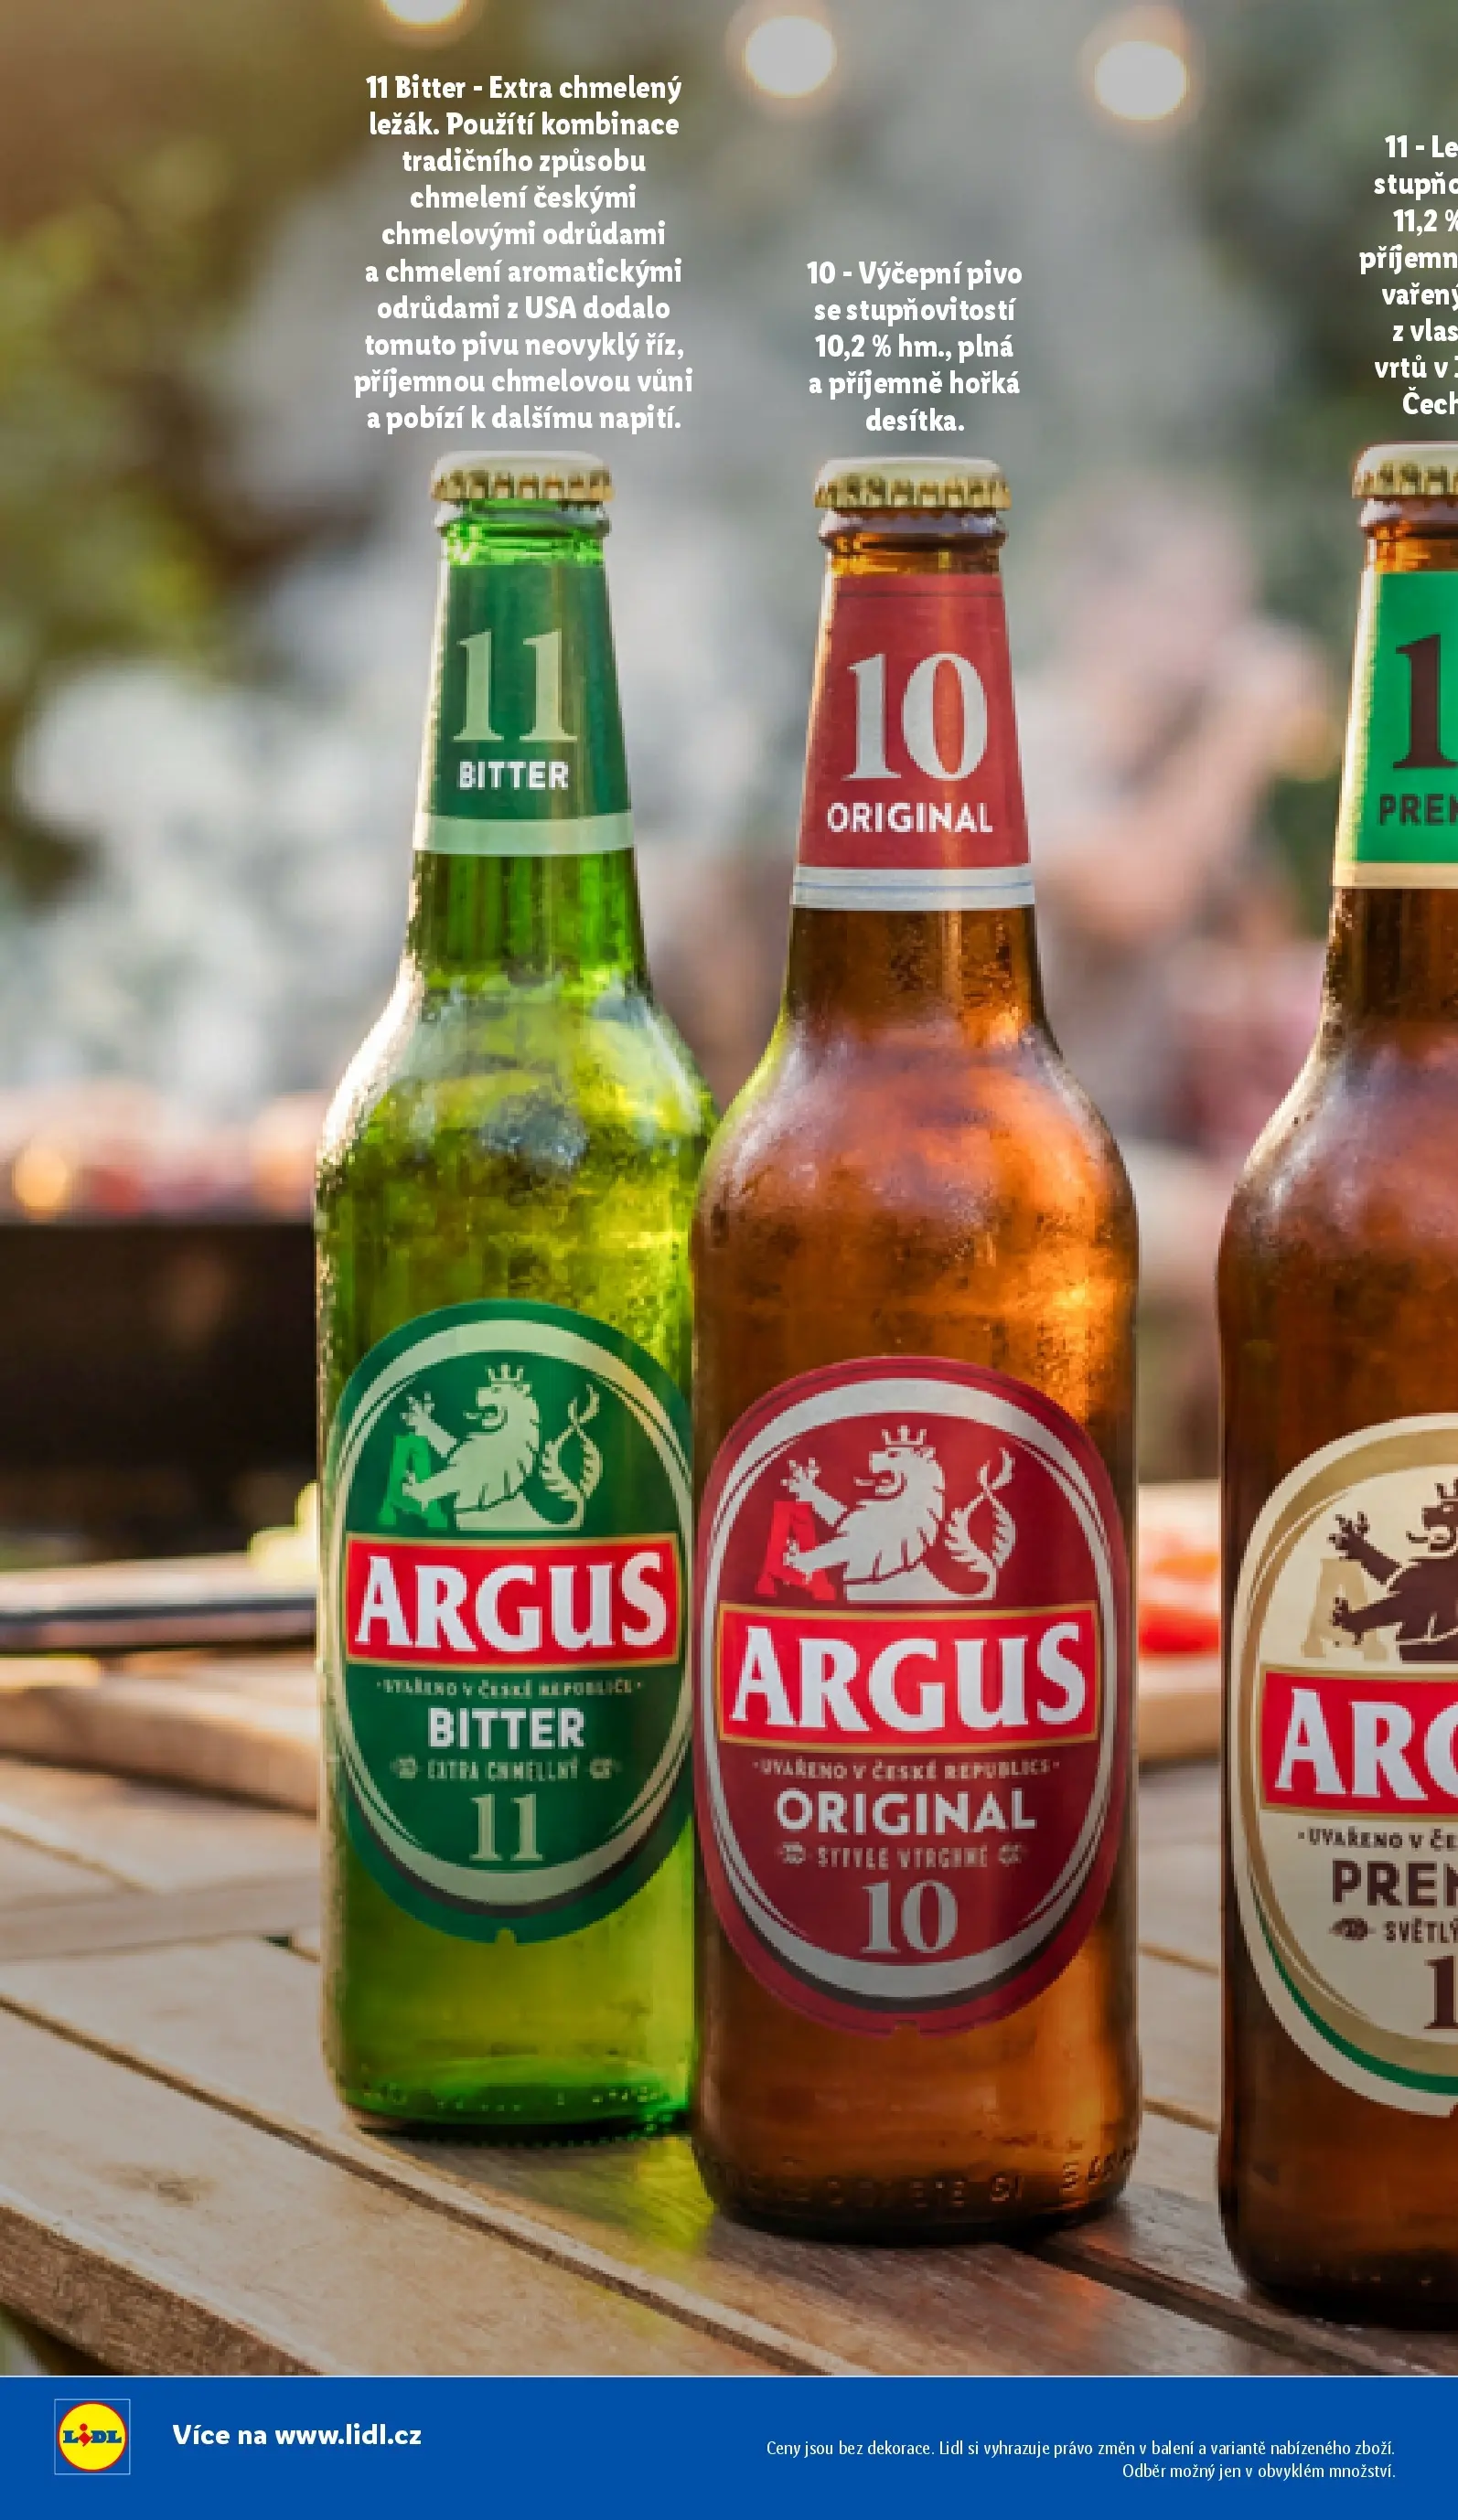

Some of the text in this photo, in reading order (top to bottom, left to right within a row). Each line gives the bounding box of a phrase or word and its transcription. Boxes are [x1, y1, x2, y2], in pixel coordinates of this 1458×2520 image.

[453, 629, 578, 742] 11
[841, 653, 988, 781] 10
[458, 761, 570, 790] BITTER
[827, 802, 993, 833] ORIGINAL
[355, 1551, 668, 1653] ARGUS
[731, 1621, 1087, 1733] ARGUS
[428, 1707, 584, 1749] BITTER
[470, 1793, 543, 1862] 11
[777, 1788, 1036, 1835] ORIGINAL
[861, 1879, 959, 1954] 10
